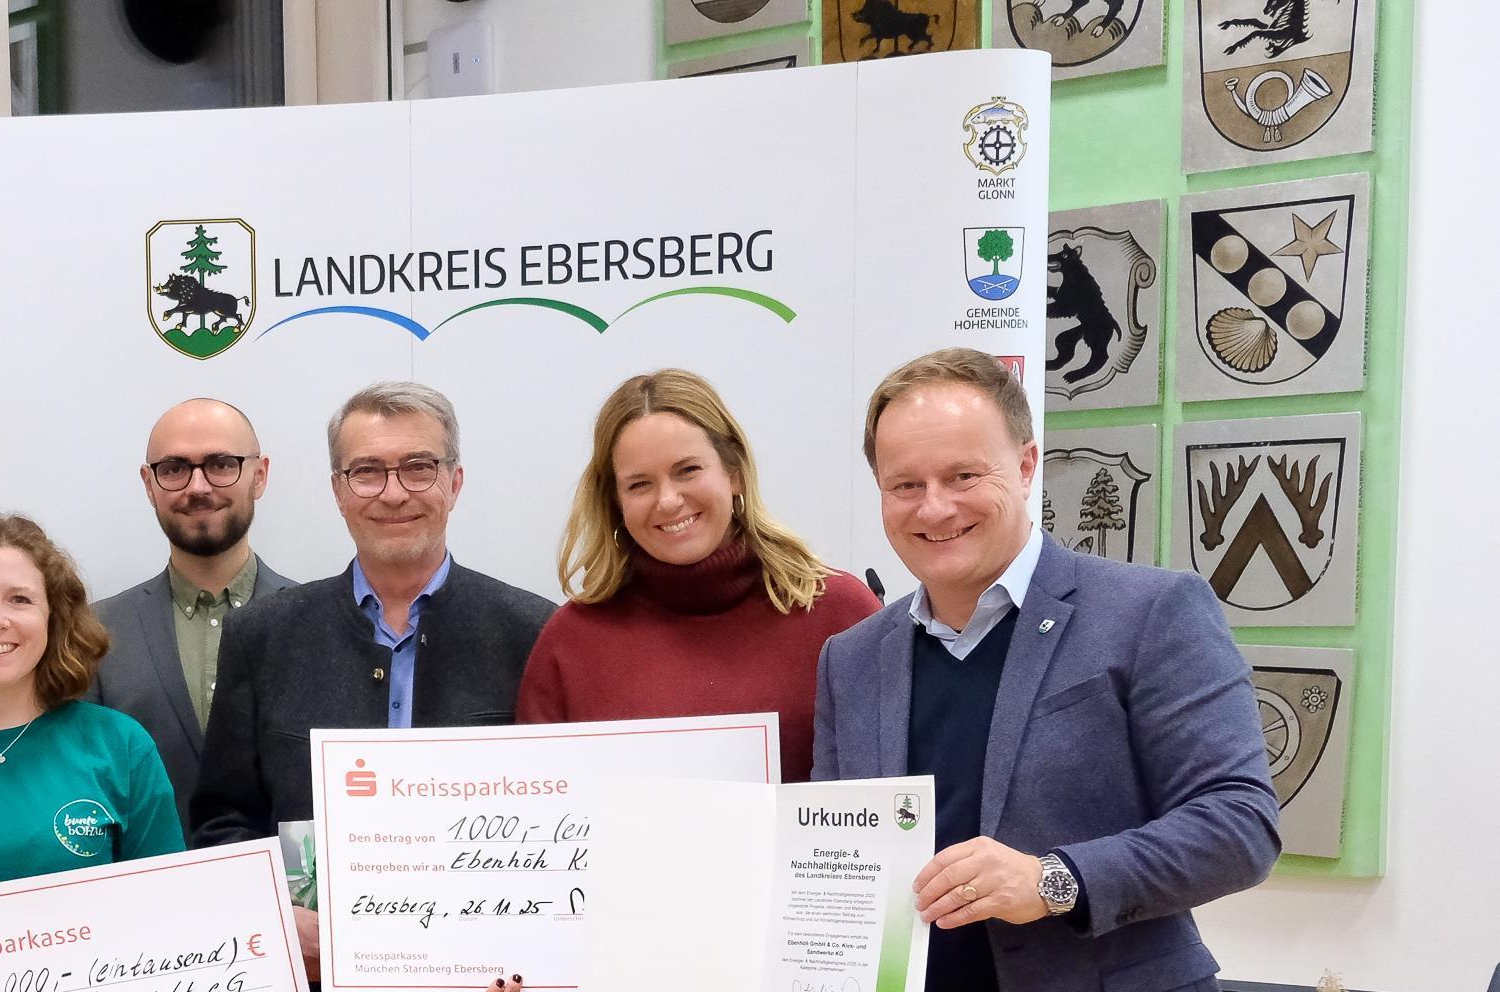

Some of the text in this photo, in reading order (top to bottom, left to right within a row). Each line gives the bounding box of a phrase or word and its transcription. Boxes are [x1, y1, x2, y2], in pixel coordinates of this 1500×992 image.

[976, 178, 1016, 190] MARKT
[977, 189, 1015, 200] GLONN
[275, 229, 774, 297] LANDKREIS EBERSBERG
[966, 307, 1020, 319] GEMEINDE
[954, 318, 1028, 330] HOHENLINDEN
[391, 775, 568, 801] Kreissparkasse
[798, 807, 879, 828] Urkunde
[349, 834, 371, 843] Den
[374, 833, 412, 845] Betrag
[414, 834, 436, 843] von
[813, 848, 860, 859] Energie- &
[350, 862, 413, 874] übergeben
[414, 862, 431, 872] wir
[432, 863, 445, 872] an
[790, 860, 882, 873] Nachhaltigkeitspreis
[844, 874, 876, 882] Ebersberg
[88, 937, 238, 987] (eintausend)
[246, 933, 267, 957] €
[354, 952, 428, 963] Kreissparkasse
[355, 964, 504, 976] München Starnberg Ebersberg
